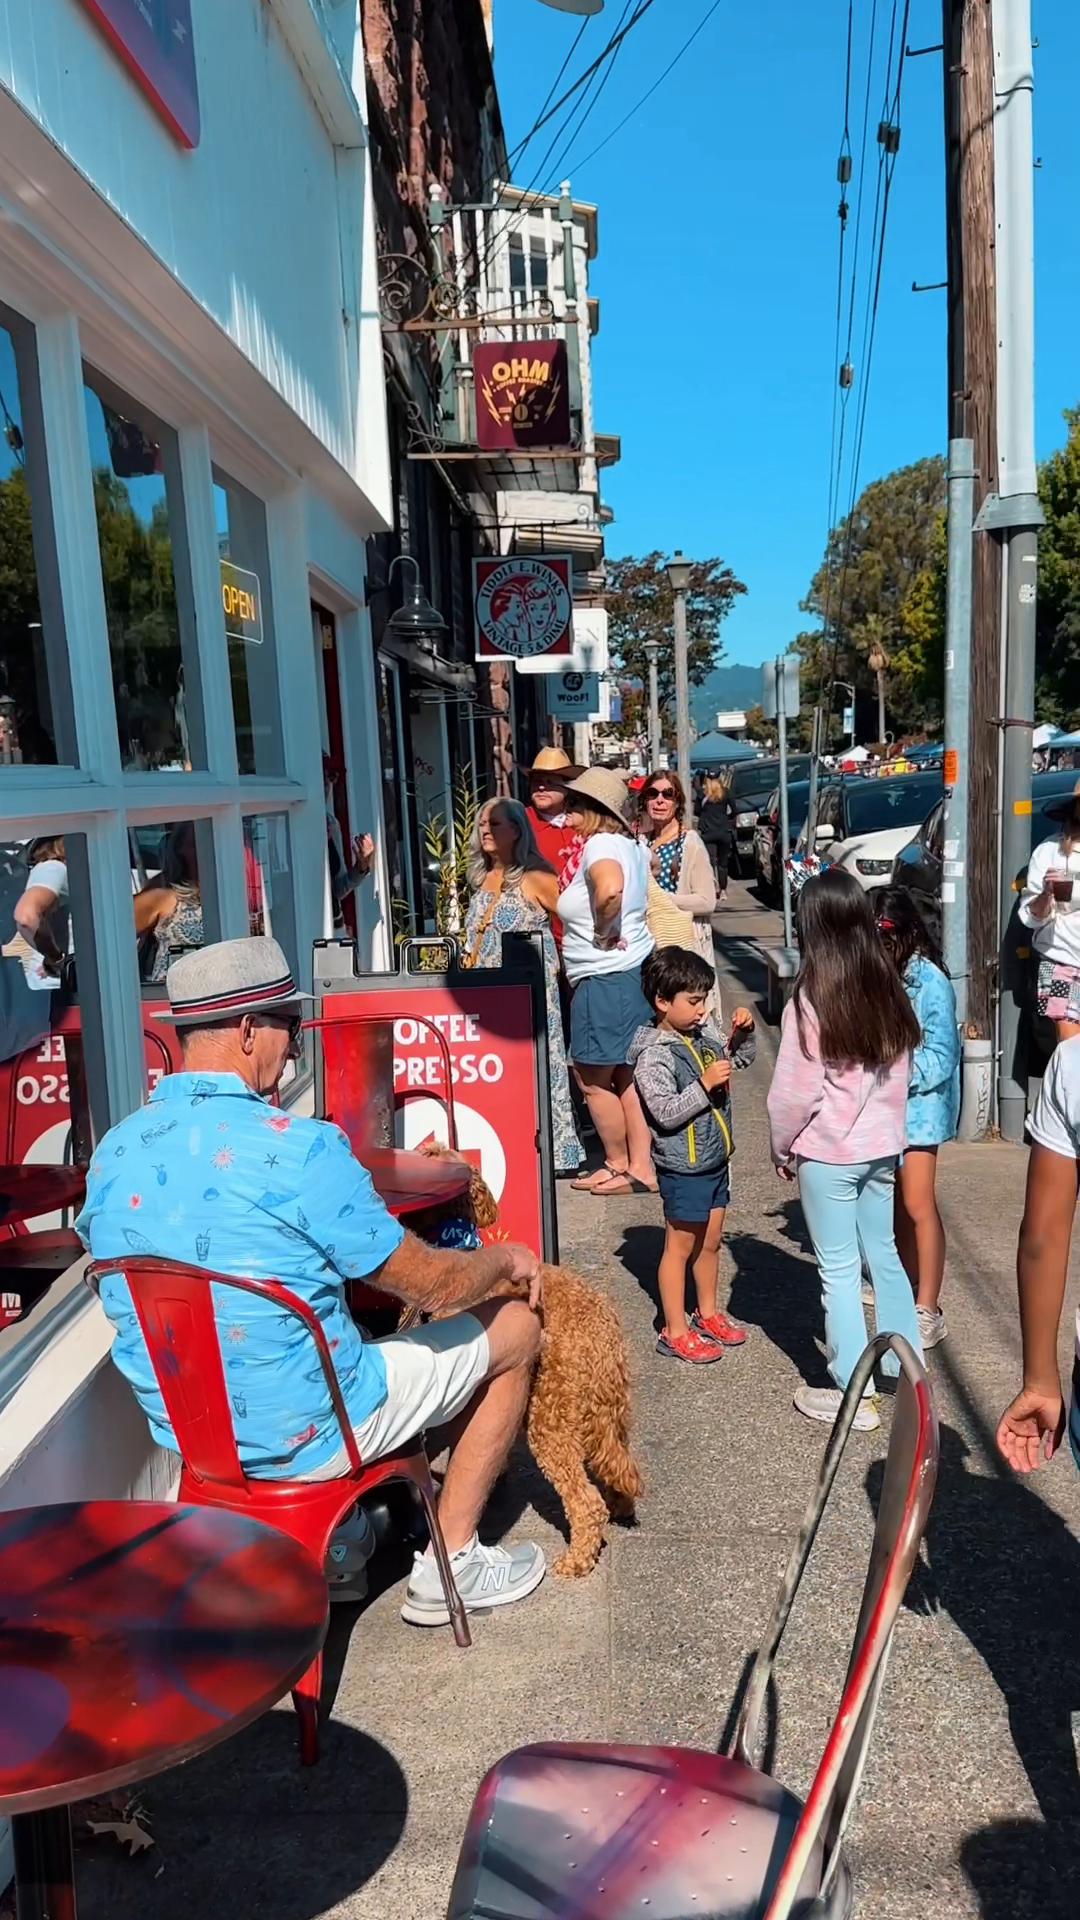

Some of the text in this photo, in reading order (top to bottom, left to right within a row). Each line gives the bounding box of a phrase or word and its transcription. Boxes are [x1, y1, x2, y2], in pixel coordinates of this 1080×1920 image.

[492, 358, 549, 381] OHM
[222, 585, 255, 621] OPEN
[483, 620, 525, 653] VINTAGE
[543, 619, 566, 645] DIME
[393, 1013, 480, 1045] OFFEE
[393, 1053, 504, 1087] PRESSO
